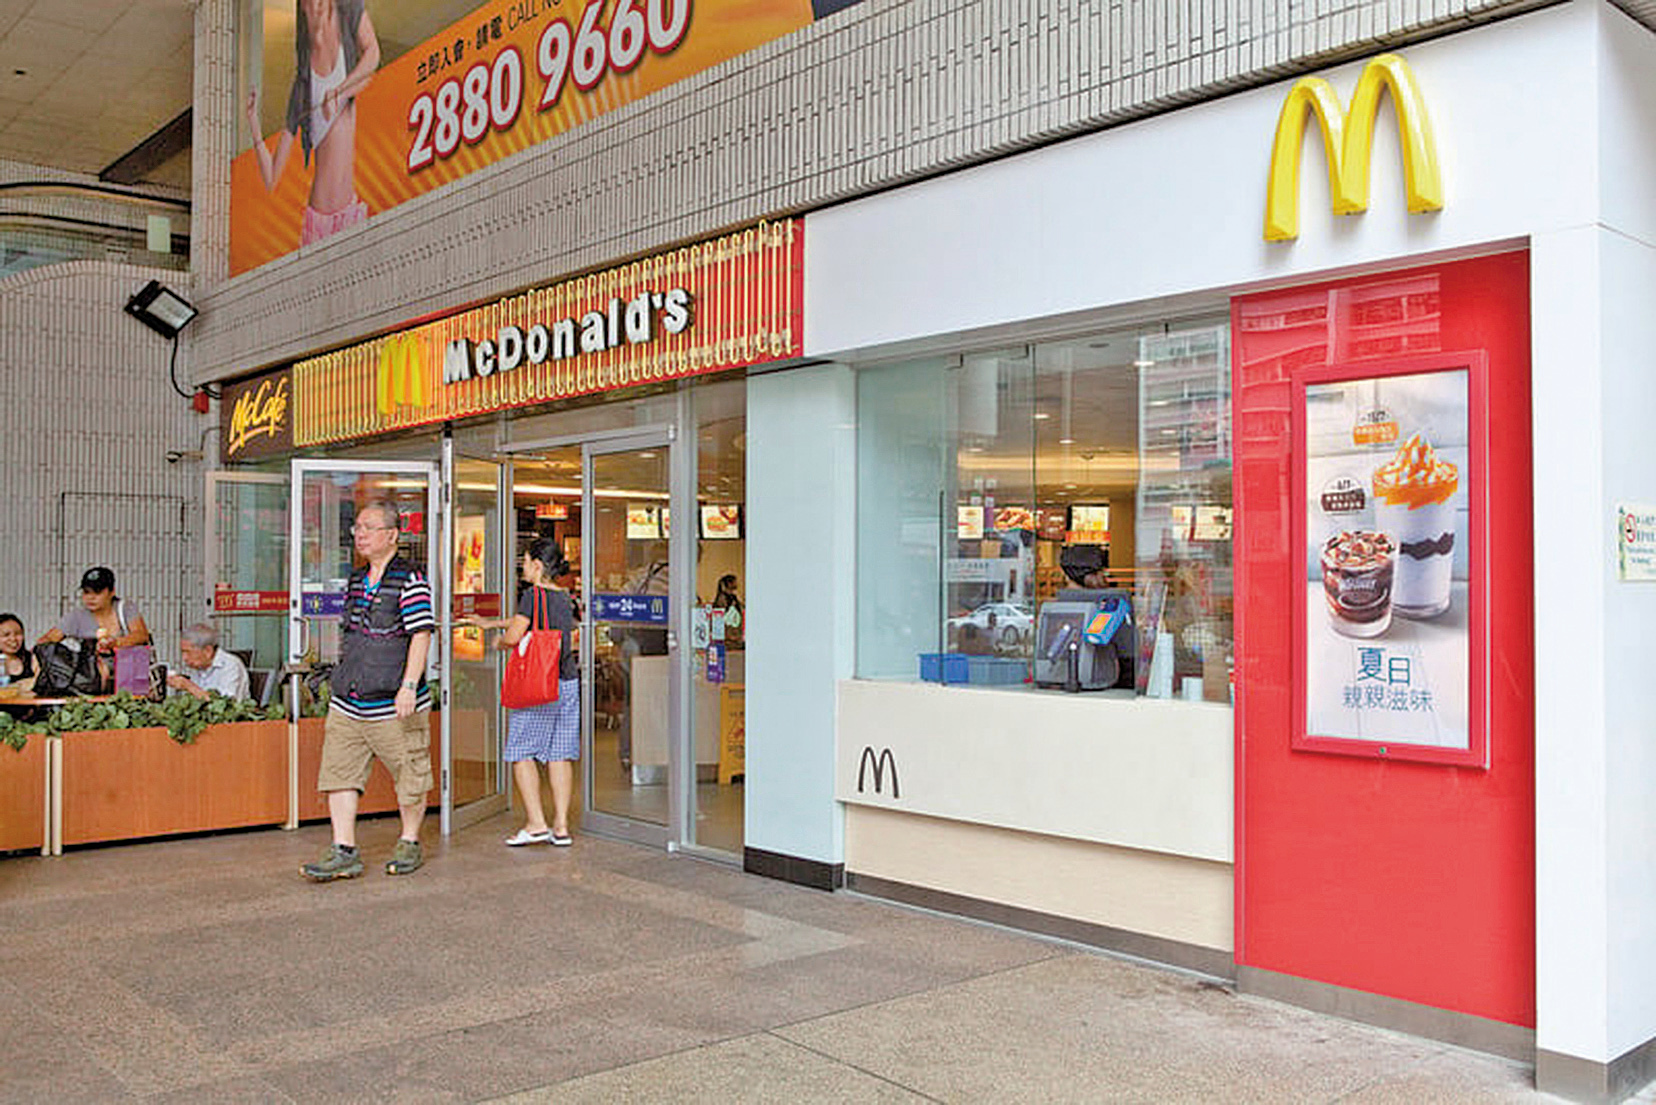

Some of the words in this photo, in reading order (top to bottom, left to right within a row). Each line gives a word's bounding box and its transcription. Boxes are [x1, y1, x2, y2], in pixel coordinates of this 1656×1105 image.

[407, 45, 523, 174] 2880
[536, 0, 691, 111] 9660
[443, 288, 695, 385] McDonald's
[1357, 647, 1411, 686] 夏日
